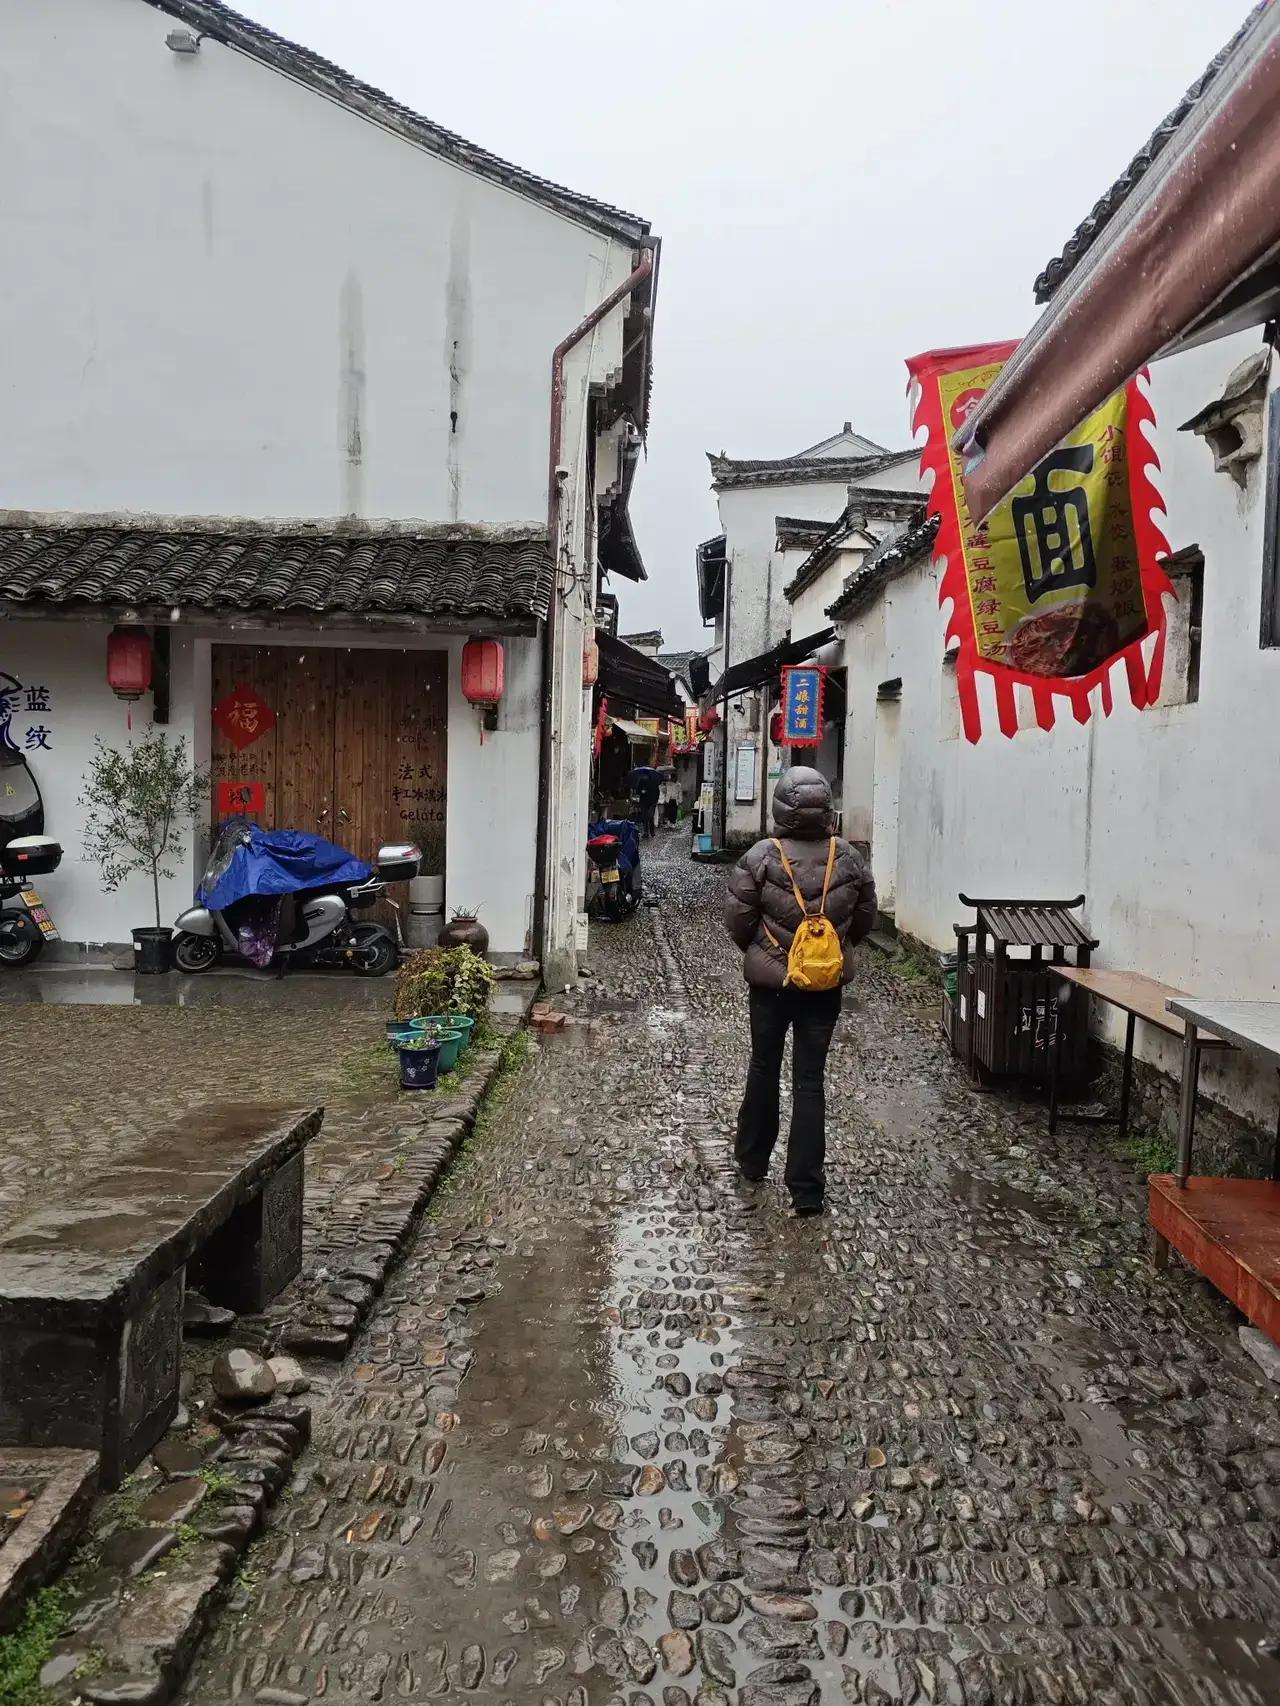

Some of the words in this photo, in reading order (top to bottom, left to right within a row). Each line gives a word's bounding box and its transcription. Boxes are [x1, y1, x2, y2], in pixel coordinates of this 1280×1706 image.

[23, 685, 54, 751] 蓝纹
[398, 763, 433, 780] 法式
[399, 809, 445, 822] Gelato
